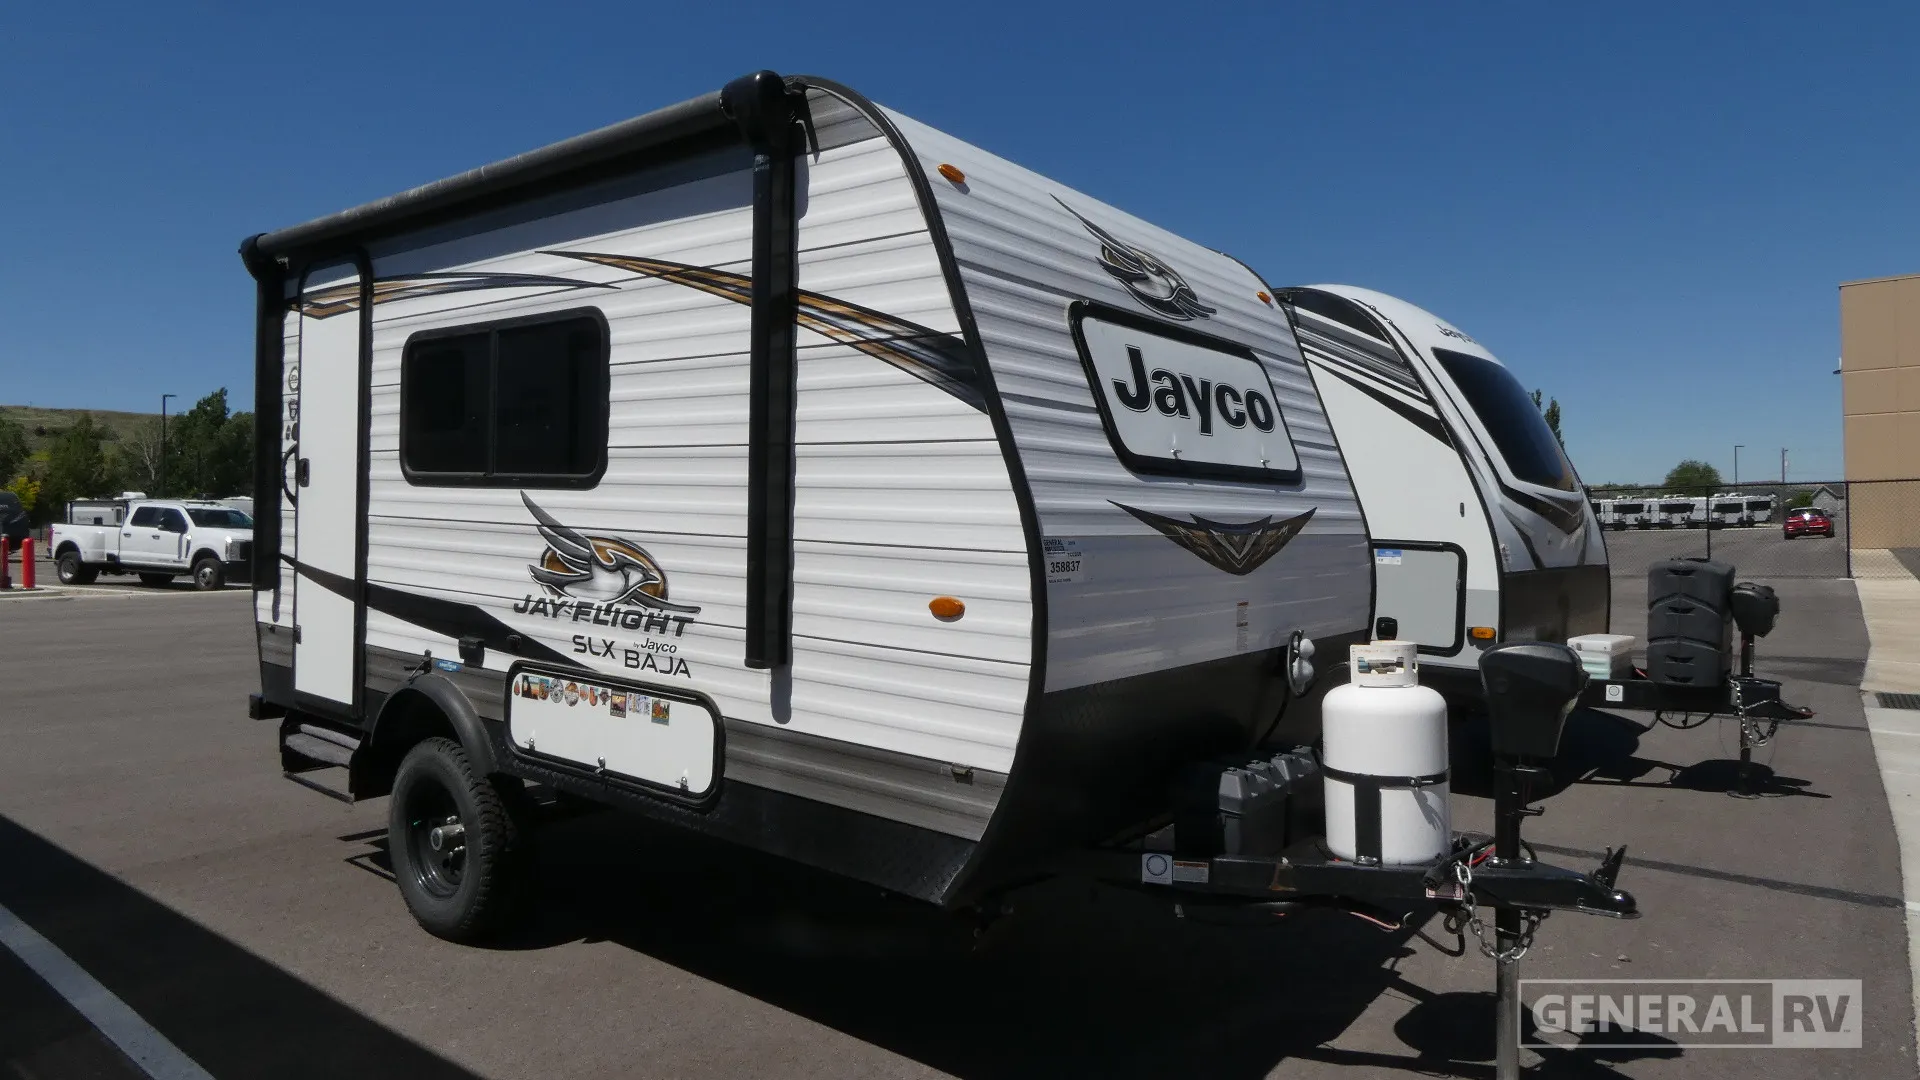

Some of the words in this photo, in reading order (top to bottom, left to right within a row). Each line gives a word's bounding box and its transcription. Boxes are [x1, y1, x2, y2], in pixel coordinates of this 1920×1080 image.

[1435, 323, 1478, 345] Jayc
[1111, 344, 1275, 437] Jayco
[1050, 560, 1081, 573] 358837
[513, 594, 572, 619] JAY
[572, 600, 695, 638] FLIGHT
[572, 634, 616, 660] SLX
[624, 649, 692, 679] BAJA
[633, 641, 641, 649] by
[640, 637, 678, 654] Jayco
